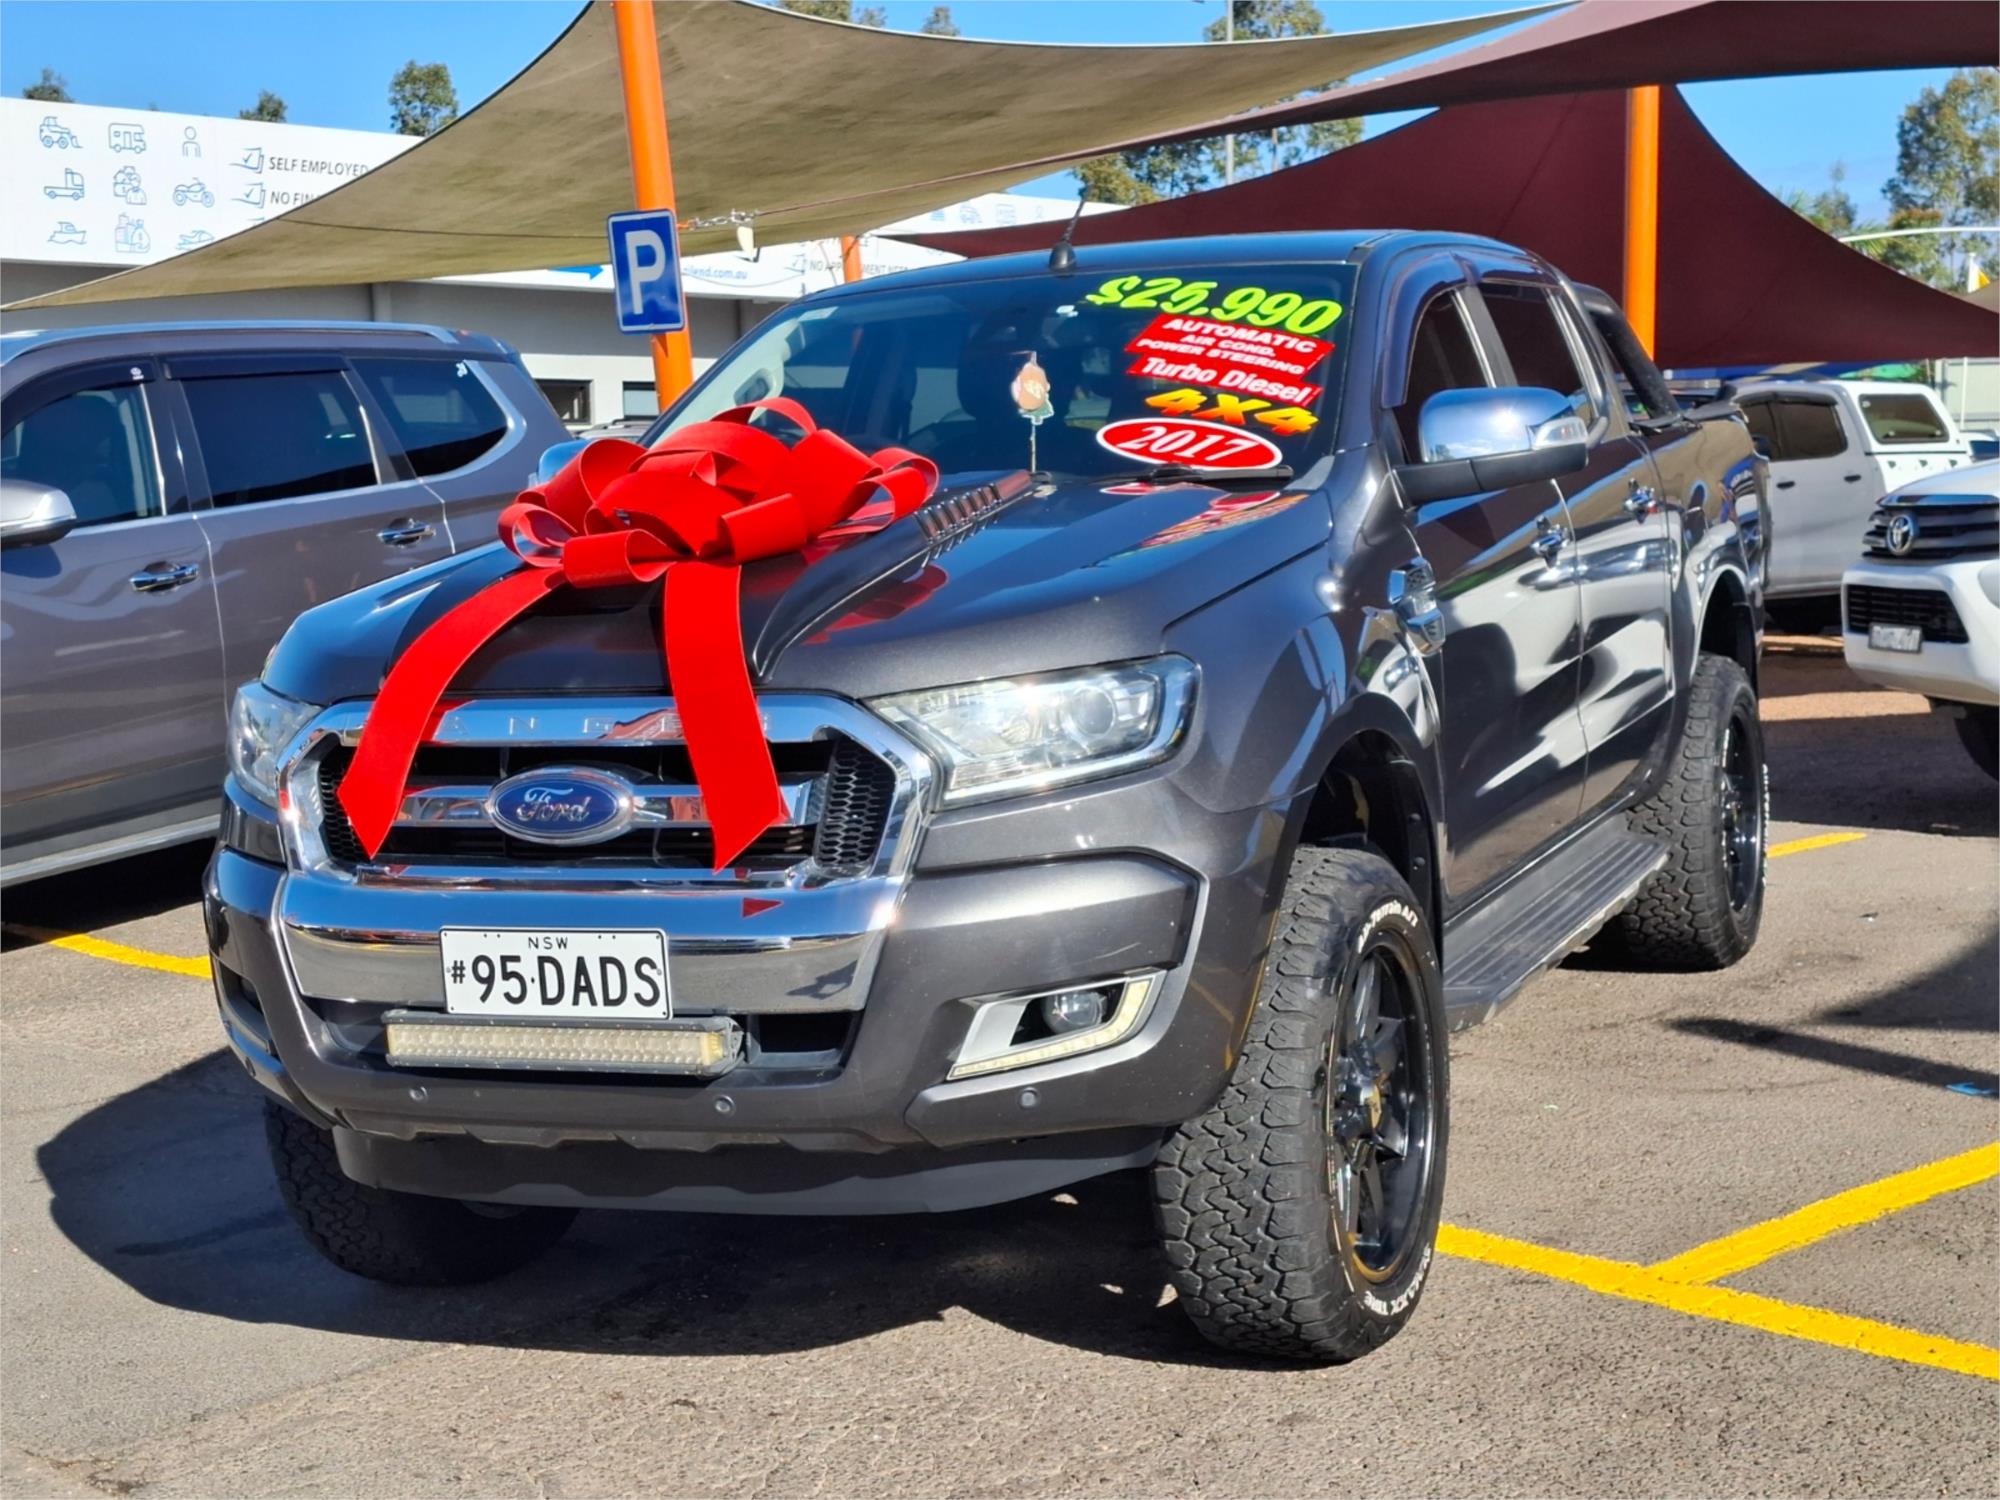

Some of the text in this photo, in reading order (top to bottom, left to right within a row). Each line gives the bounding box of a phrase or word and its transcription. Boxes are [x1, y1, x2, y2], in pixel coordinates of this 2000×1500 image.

[268, 156, 369, 176] SELF EMPLOYED
[270, 190, 290, 205] NO
[624, 228, 666, 315] P
[1162, 318, 1317, 353] AUTOMATIC
[1180, 334, 1276, 357] AIR COND.
[1136, 338, 1306, 375] POWER STEERING
[1142, 356, 1312, 403] Turbo Diesel
[1116, 425, 1258, 462] 2017
[516, 787, 592, 821] Ford
[528, 936, 568, 950] NSW
